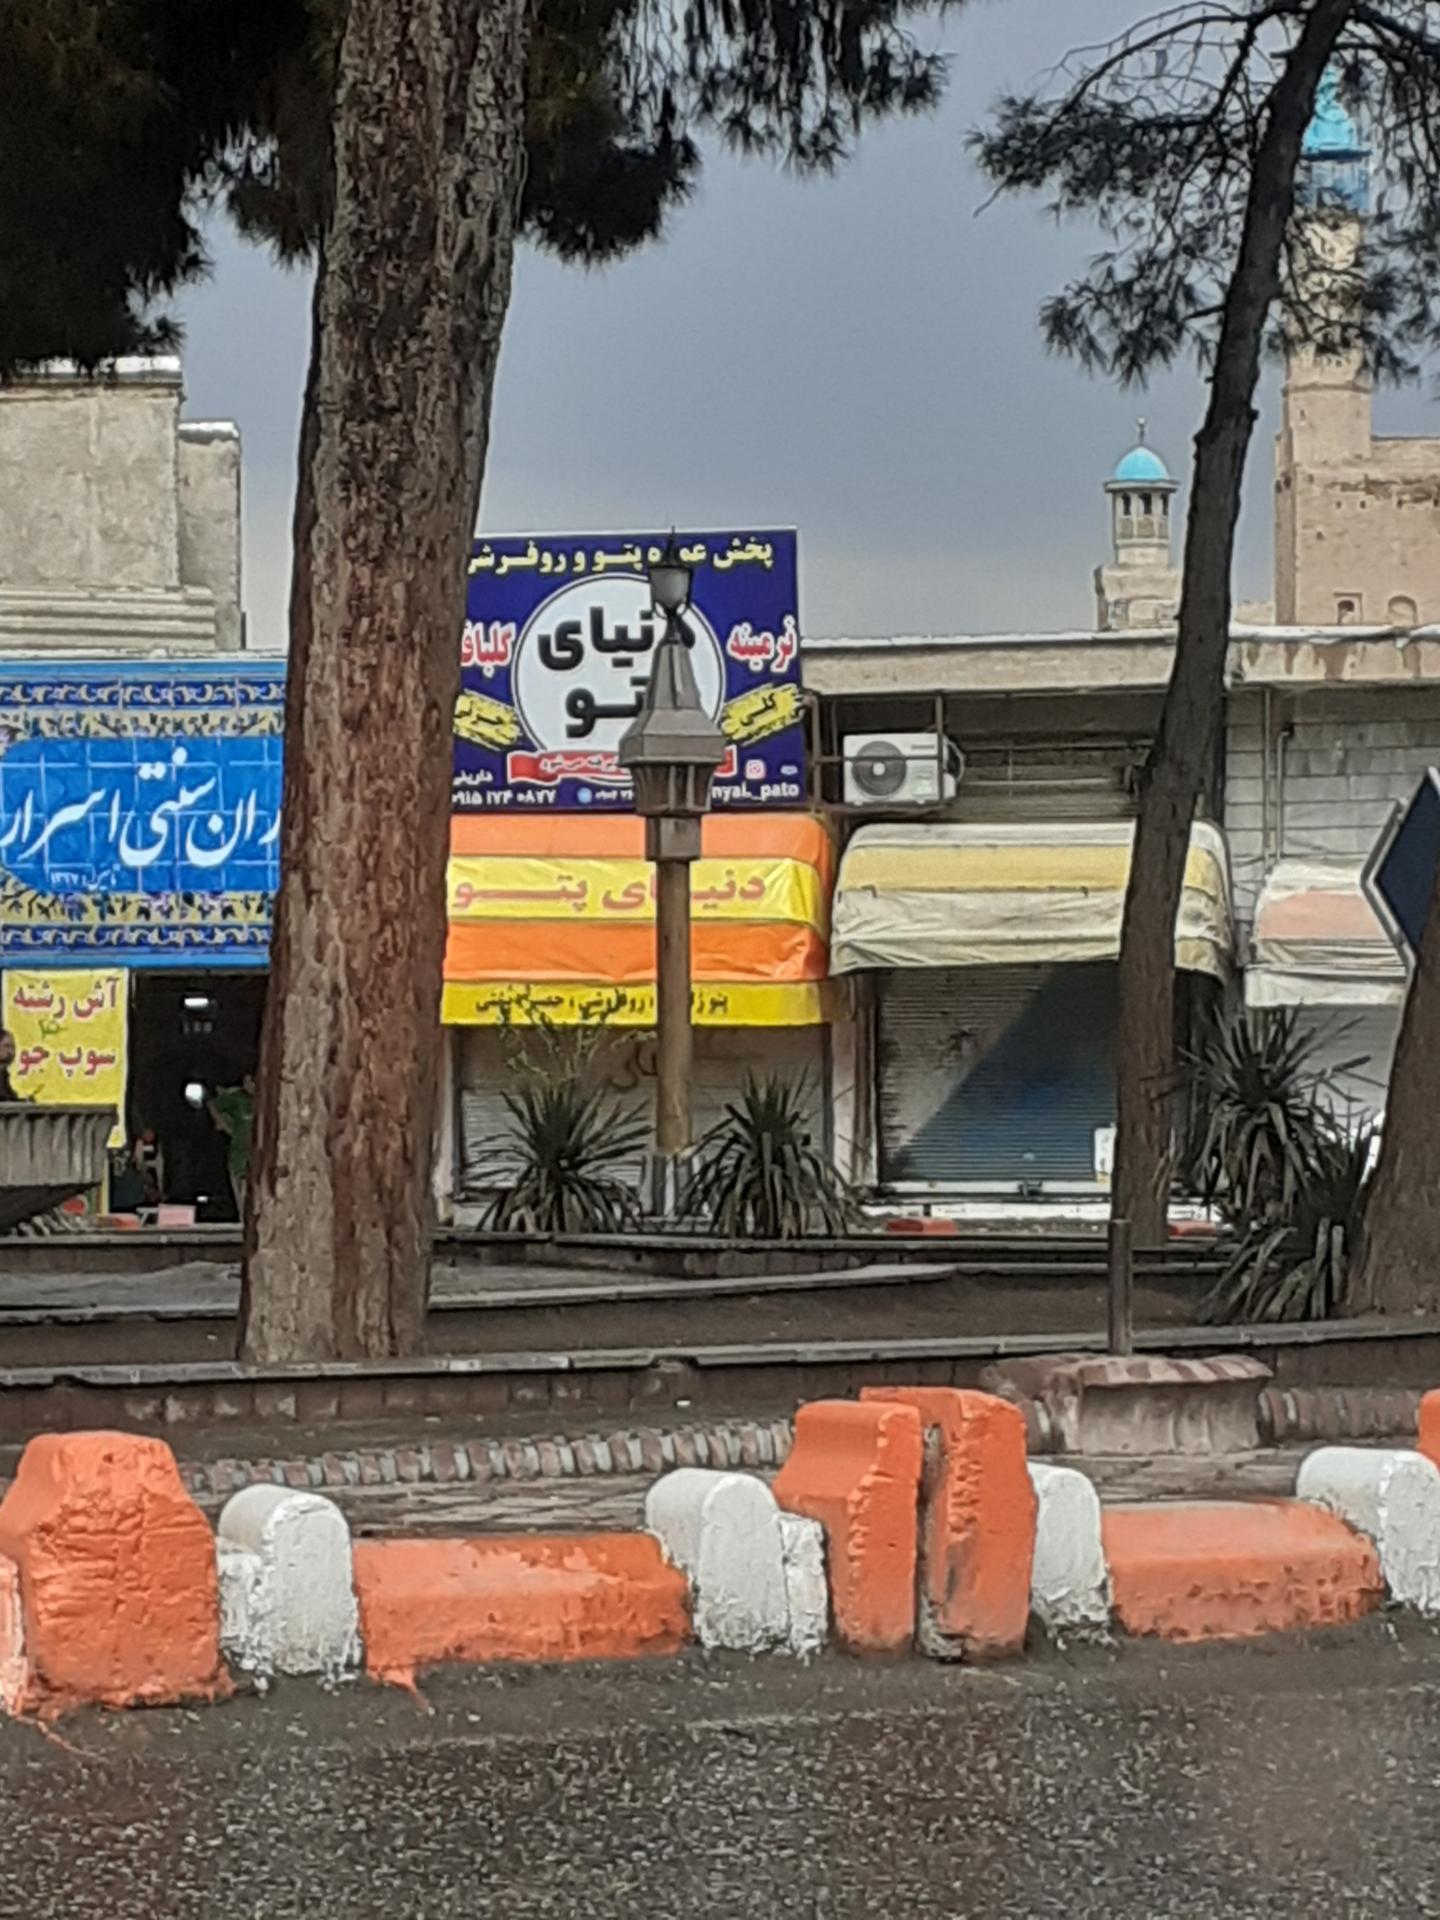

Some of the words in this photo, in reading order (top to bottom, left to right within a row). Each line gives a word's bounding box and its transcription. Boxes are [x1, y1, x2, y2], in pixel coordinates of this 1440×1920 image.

[573, 551, 585, 573] و
[592, 543, 643, 572] پتو
[648, 544, 706, 563] عمه
[713, 537, 773, 568] پخش
[538, 606, 654, 671] نیای
[452, 874, 587, 912] پتو
[13, 980, 66, 1019] رشته
[73, 976, 119, 1018] آش
[18, 1046, 49, 1076] جو
[59, 1046, 116, 1077] سوپ
